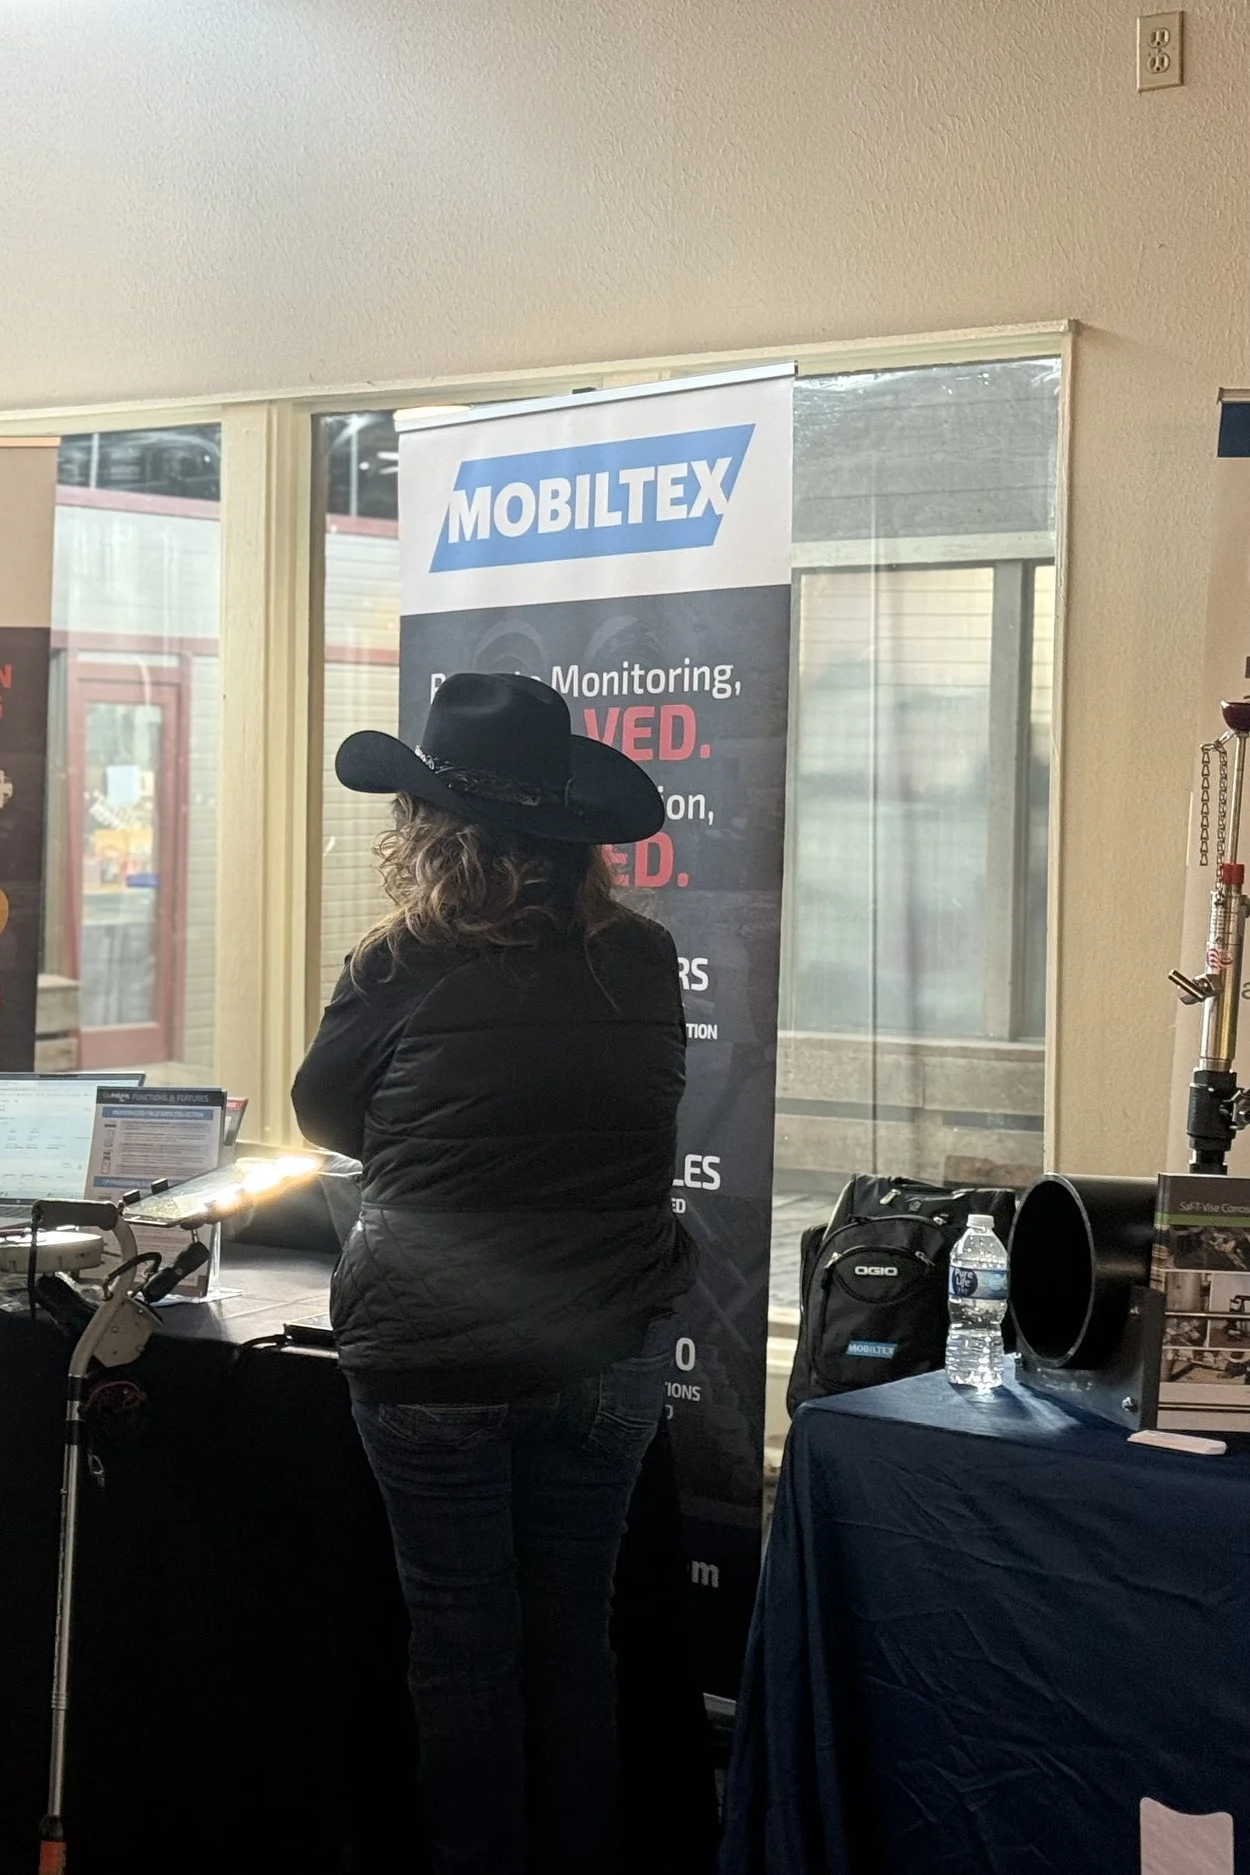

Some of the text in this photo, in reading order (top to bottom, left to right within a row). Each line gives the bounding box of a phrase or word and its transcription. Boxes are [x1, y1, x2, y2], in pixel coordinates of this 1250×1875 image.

[448, 456, 733, 544] MOBILTEX
[551, 657, 742, 699] Monitoring,
[583, 703, 711, 761] VED.
[601, 831, 689, 888] ED.
[677, 956, 709, 991] RS
[685, 1022, 718, 1040] TION
[855, 1265, 898, 1277] OGIO
[955, 1268, 974, 1279] Pure
[956, 1277, 971, 1288] Life
[664, 1381, 703, 1402] IONS
[690, 1560, 720, 1588] m
